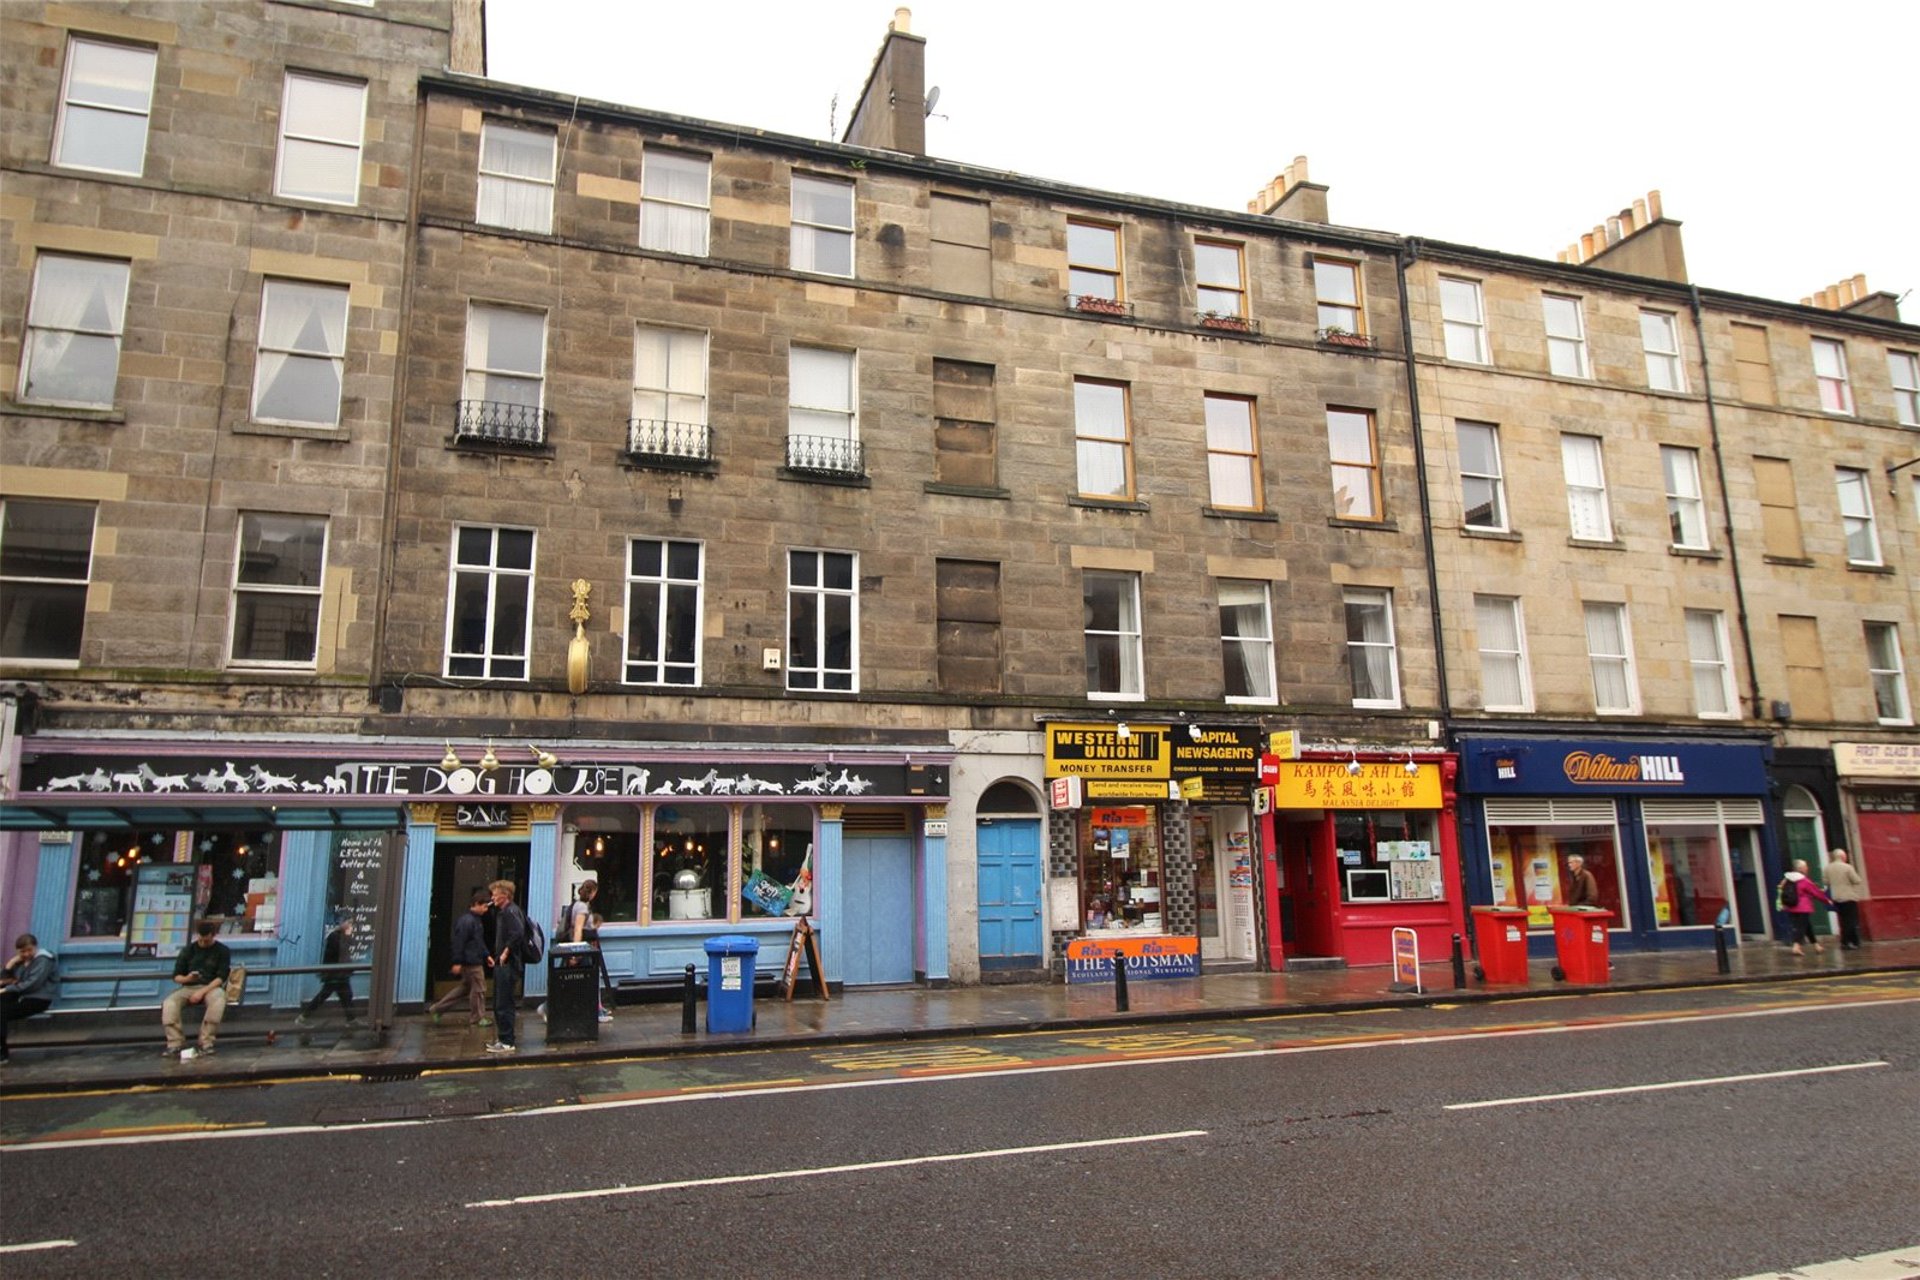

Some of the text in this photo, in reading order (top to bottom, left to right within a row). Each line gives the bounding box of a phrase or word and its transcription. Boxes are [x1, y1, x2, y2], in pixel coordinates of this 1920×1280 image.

[1057, 732, 1139, 745] WESTERN
[1085, 746, 1139, 758] UNION
[1177, 747, 1254, 759] NEWSAGENTS
[1060, 765, 1153, 773] MONEY TRANSFER
[1294, 766, 1366, 778] KAMPOG
[1370, 766, 1390, 778] AH
[1498, 766, 1516, 778] HILL
[1564, 751, 1684, 783] William HILL
[362, 764, 620, 796] THE DOG HOUSE
[1102, 814, 1122, 823] Ria
[1081, 946, 1102, 956] Ria
[1142, 943, 1162, 954] Ria
[1074, 954, 1194, 970] THE SOTSMAN
